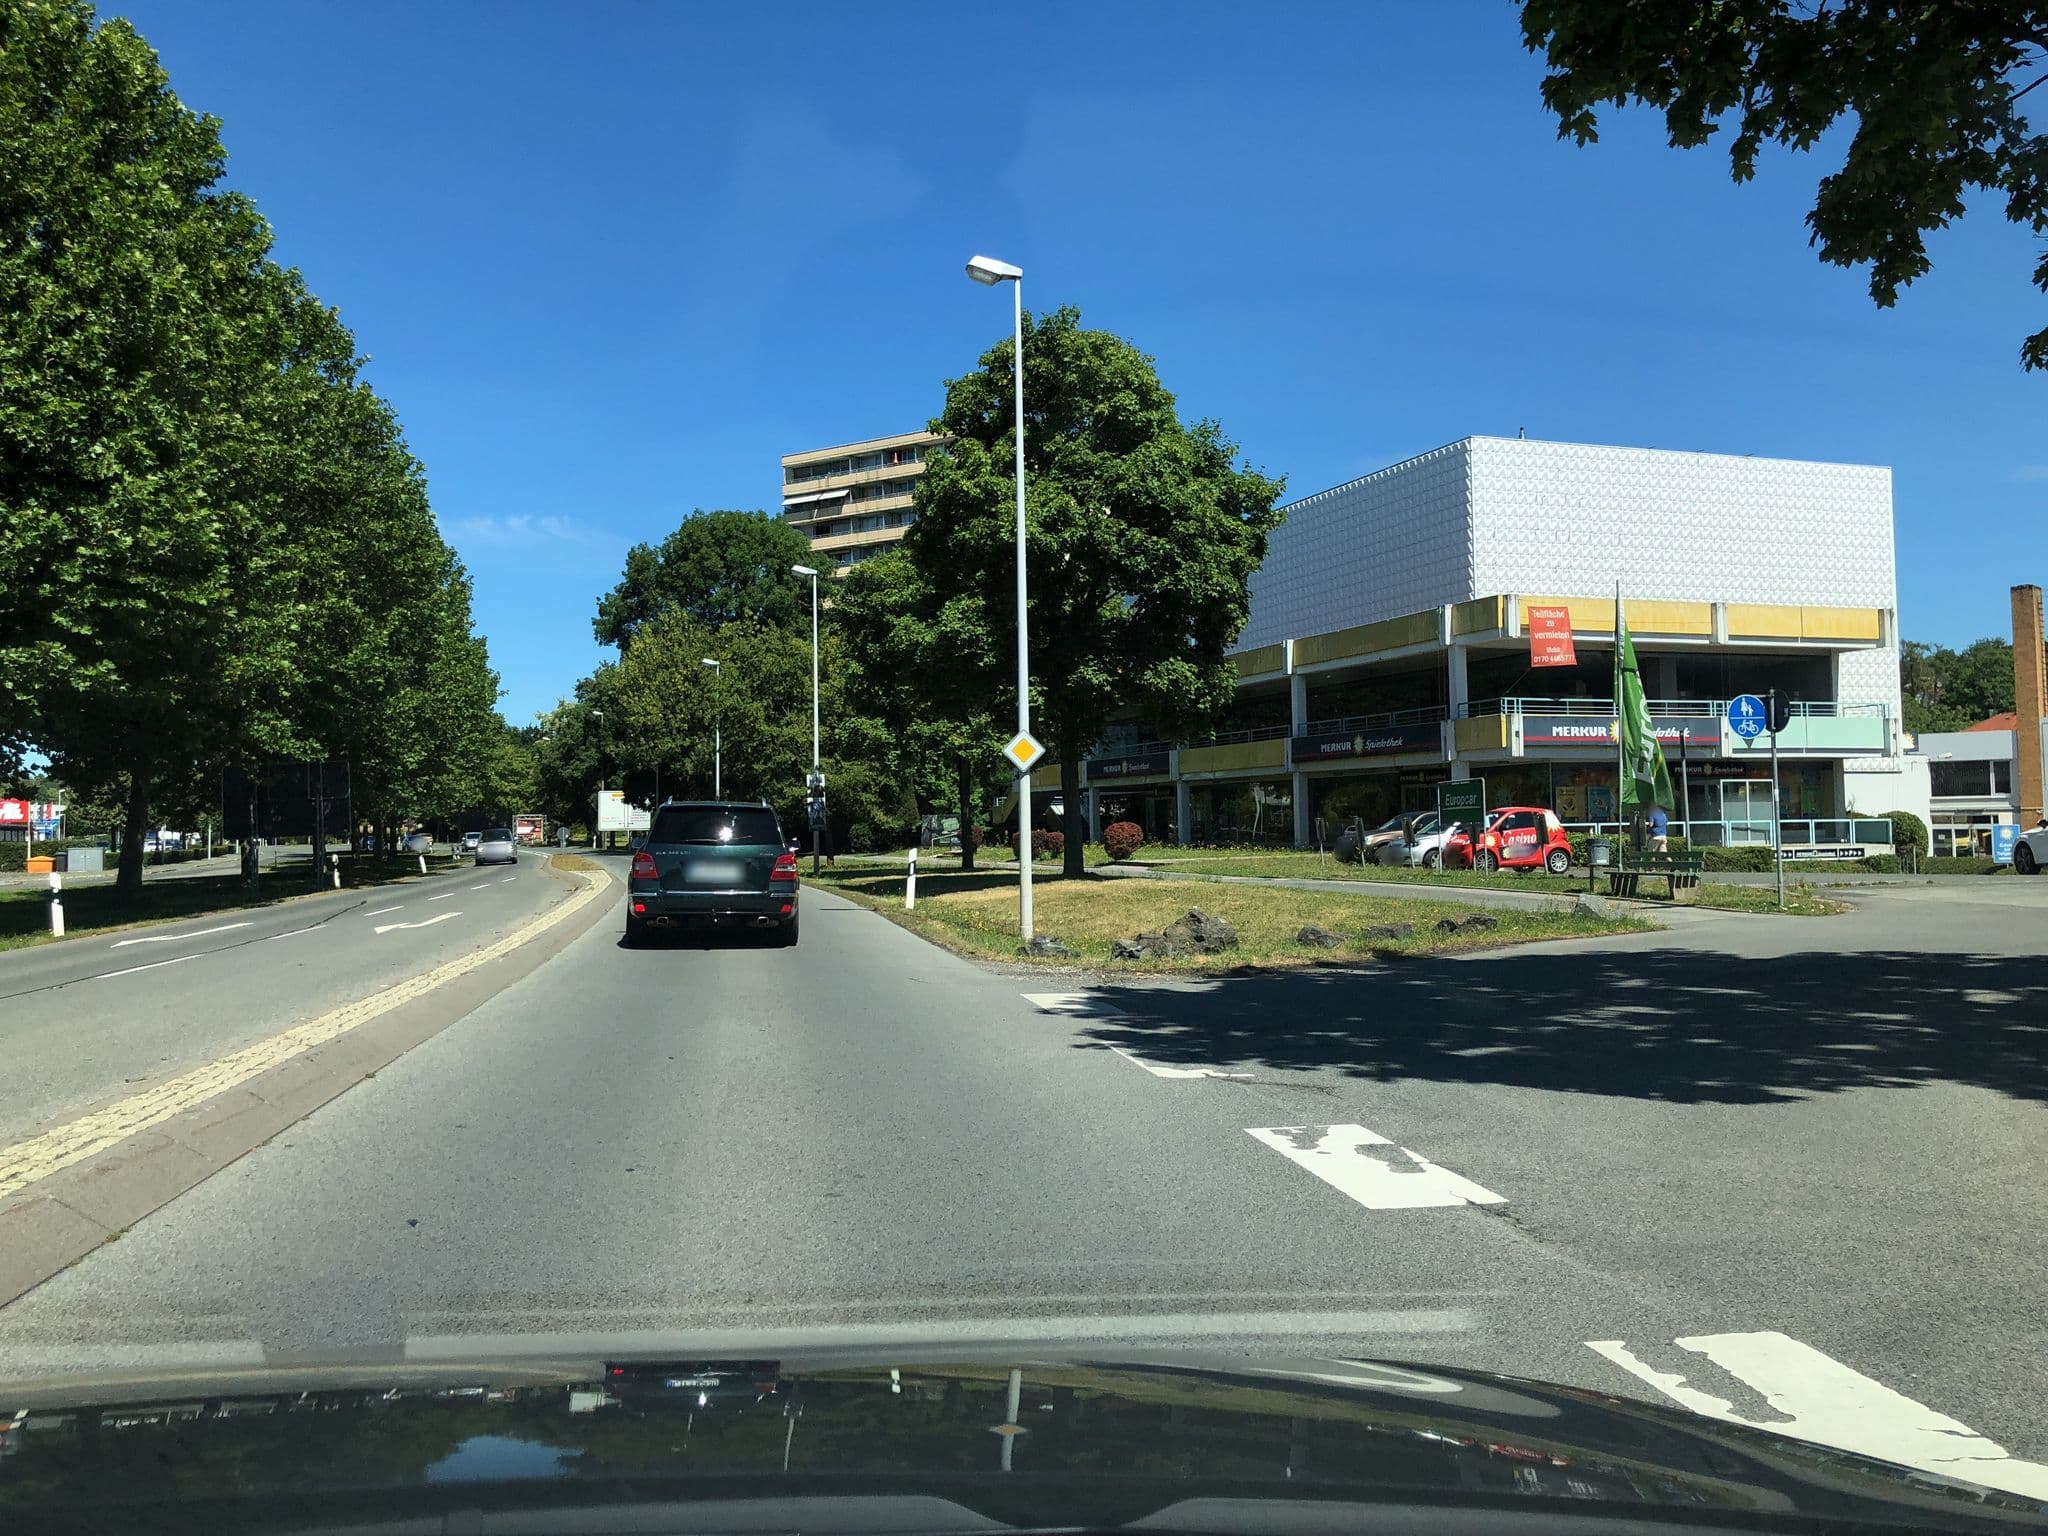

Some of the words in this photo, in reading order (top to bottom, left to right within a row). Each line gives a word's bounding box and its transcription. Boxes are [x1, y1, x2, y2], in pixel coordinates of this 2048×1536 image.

[1534, 631, 1570, 640] vermieten
[1552, 726, 1607, 737] MERKUR
[1320, 742, 1352, 753] MERKUR
[1444, 793, 1478, 807] Europcar
[1501, 829, 1538, 847] Casino
